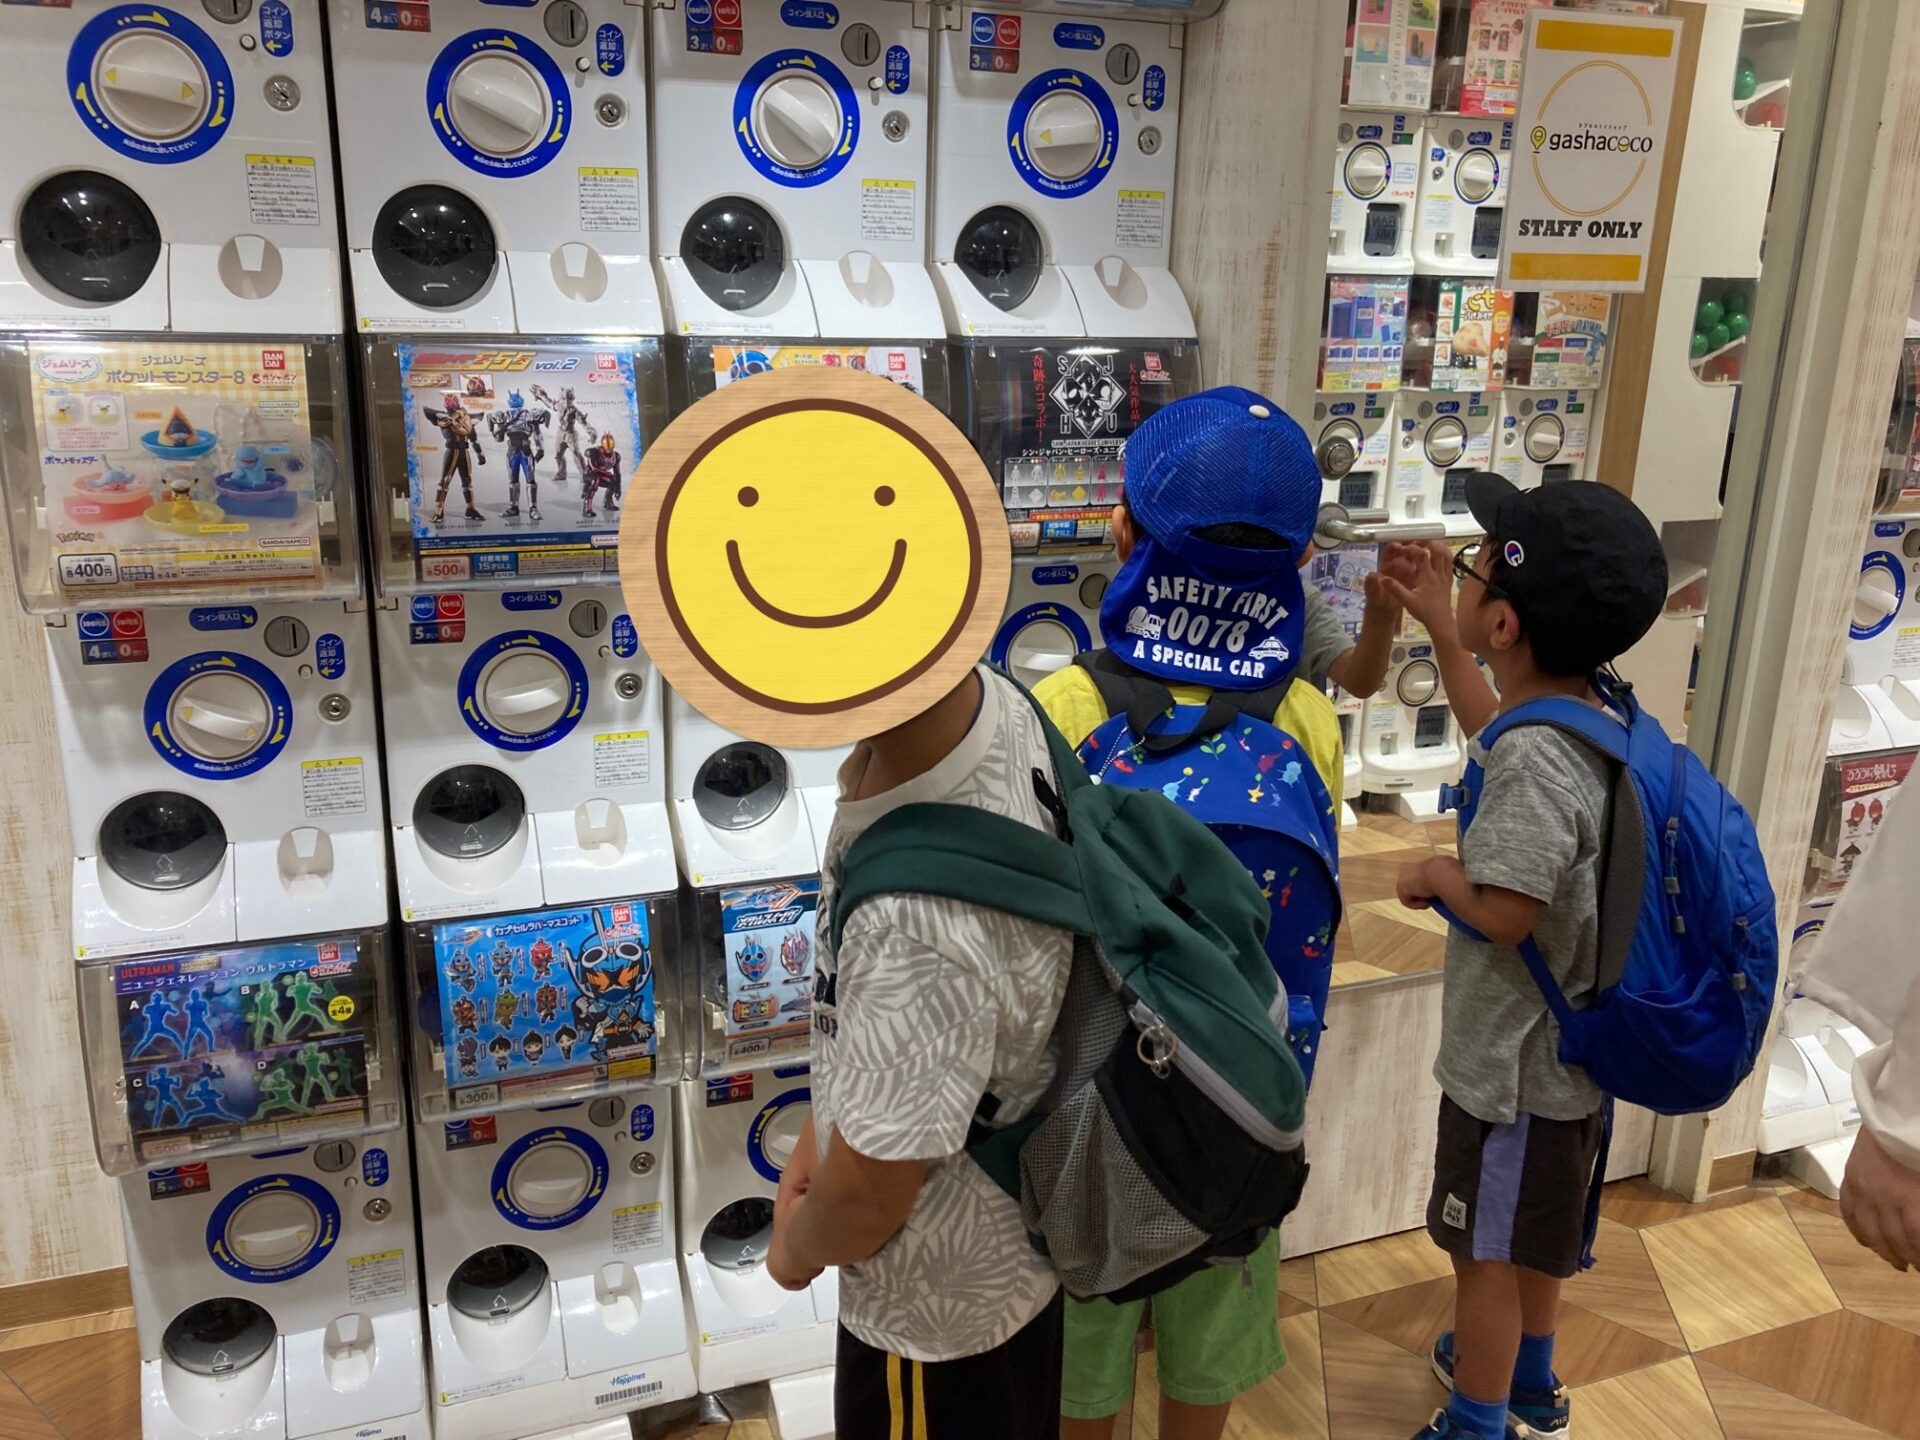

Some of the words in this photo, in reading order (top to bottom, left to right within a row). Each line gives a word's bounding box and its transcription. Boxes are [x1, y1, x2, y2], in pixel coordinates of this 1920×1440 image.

[599, 29, 622, 39] コイン
[599, 51, 624, 61] ボタン
[887, 51, 909, 60] コイン
[887, 71, 909, 80] ボタン
[1549, 129, 1654, 153] gashacoco
[1518, 219, 1583, 237] STAFF
[1587, 221, 1643, 239] ONLY
[141, 355, 207, 366] ジェムリーズ
[263, 352, 283, 361] BAN
[41, 359, 92, 369] ジェムリーズ
[264, 360, 281, 368] DAI
[535, 358, 580, 370] vol.2
[1056, 355, 1069, 375] S
[1103, 355, 1114, 375] J
[106, 369, 246, 385] ポケットモンスター8
[1060, 413, 1072, 435] H
[1106, 413, 1118, 433] U
[1146, 576, 1232, 610] SAFETY
[1232, 591, 1290, 631] FIRST
[1167, 606, 1251, 653] 0078
[318, 638, 341, 647] コイン
[319, 657, 343, 667] ボタン
[1132, 640, 1145, 659] A
[1152, 644, 1223, 673] SPECIAL
[1229, 659, 1266, 679] CAR
[493, 916, 581, 937] カプセルラバーマスコット
[121, 969, 240, 992] ニュージェネレーション
[246, 959, 307, 975] ウルトラマン
[241, 986, 250, 995] B
[129, 1000, 140, 1010] A
[256, 1061, 267, 1071] D
[132, 1078, 143, 1088] C
